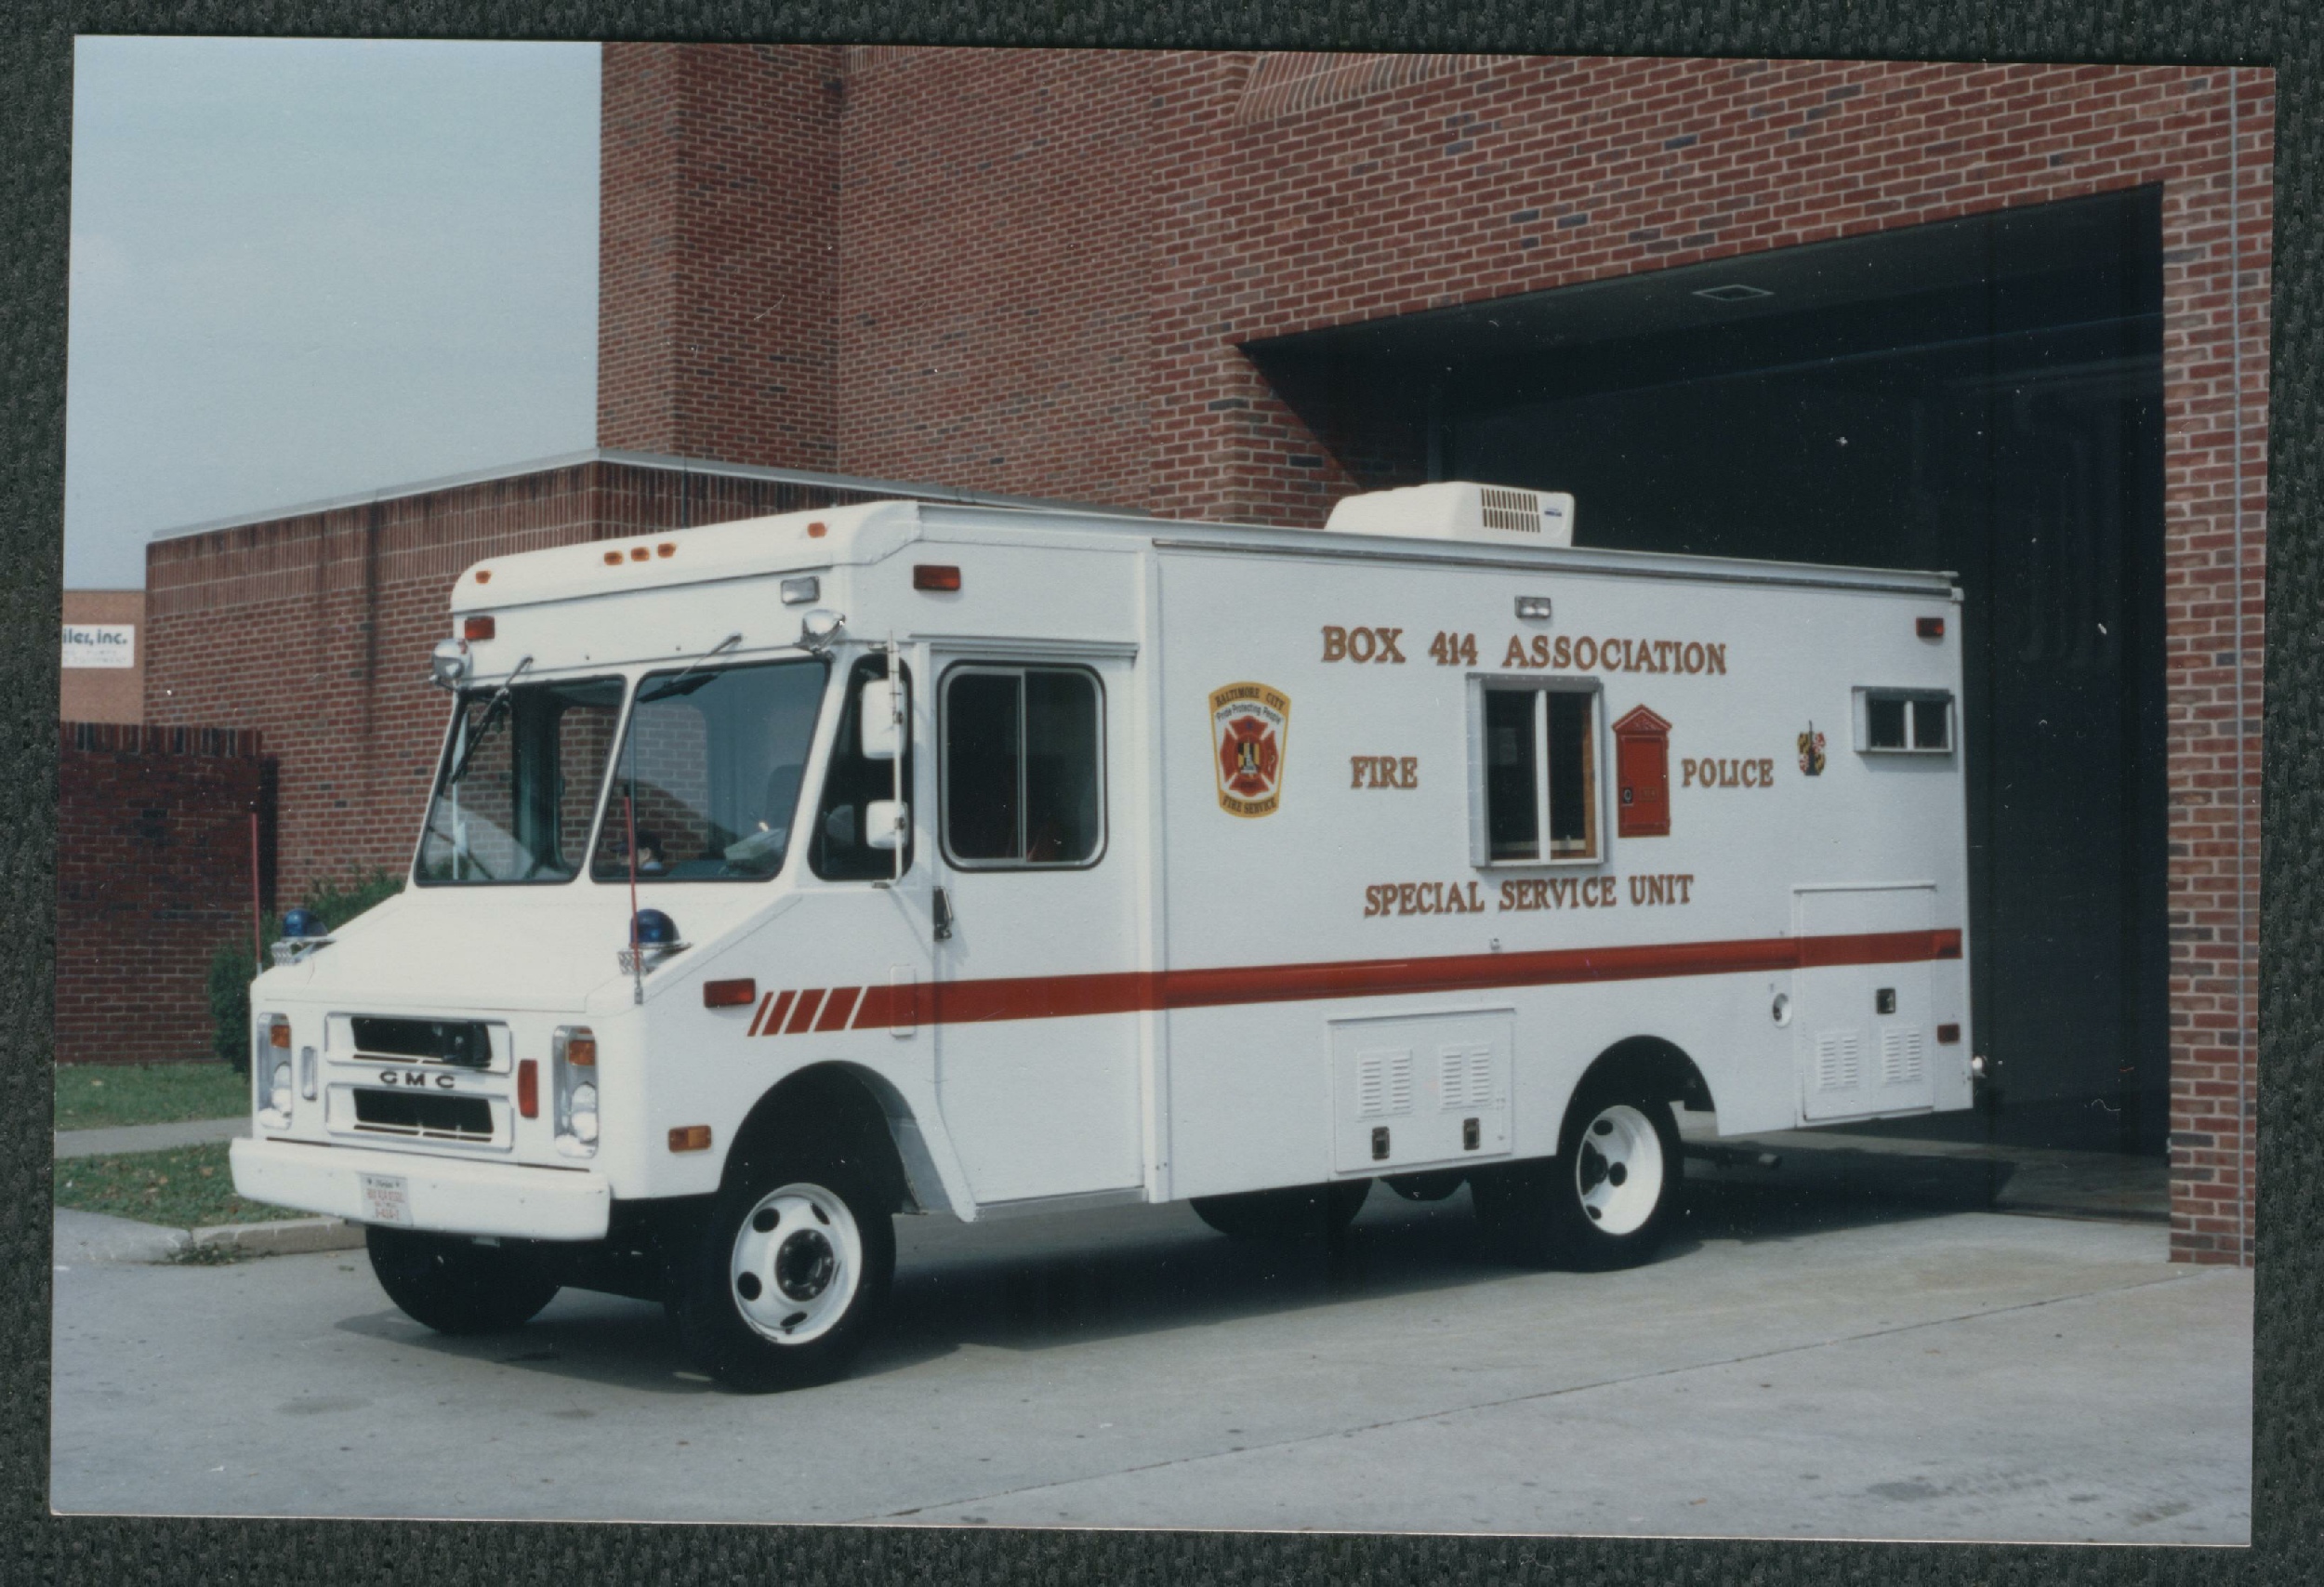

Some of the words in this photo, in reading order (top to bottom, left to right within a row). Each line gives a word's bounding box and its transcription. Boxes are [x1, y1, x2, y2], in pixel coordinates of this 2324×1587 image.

[97, 628, 127, 644] inc.
[1321, 624, 1406, 665] BOX
[1428, 628, 1479, 667] 414
[1501, 634, 1727, 676] ASSOCIATION
[1215, 686, 1260, 708] BALTIMORE
[1266, 692, 1285, 710] CITY
[1350, 754, 1419, 790] FIRE
[1681, 757, 1775, 788] POLICE
[1222, 795, 1242, 813] FIRE
[1243, 796, 1277, 814] SERVICE
[1362, 879, 1486, 918] SPECIAL
[1498, 875, 1618, 912] SERVICE
[1629, 873, 1694, 906] UNIT
[379, 1070, 455, 1089] GMC
